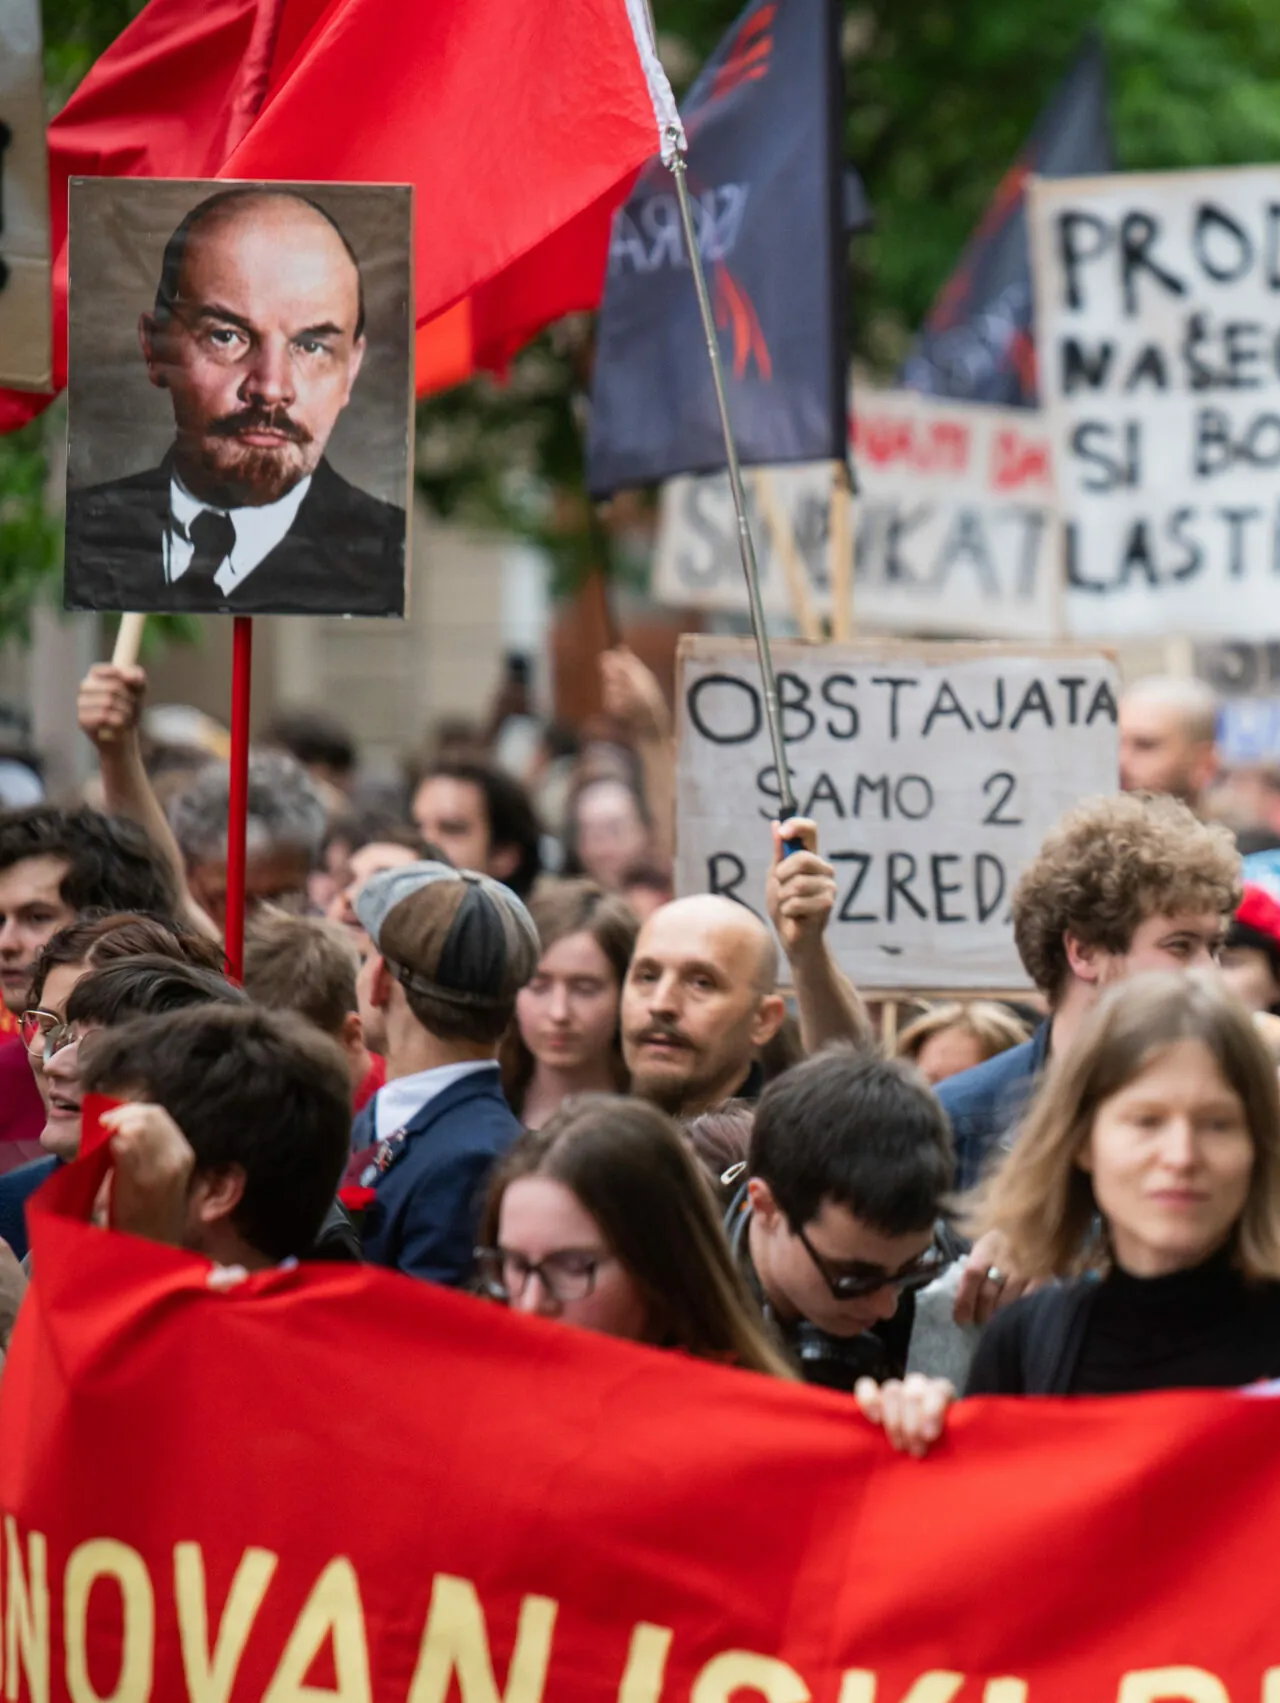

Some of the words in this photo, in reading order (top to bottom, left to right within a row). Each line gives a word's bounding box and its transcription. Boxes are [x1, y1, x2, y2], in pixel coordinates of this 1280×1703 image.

[1070, 416, 1142, 492] SI
[687, 672, 1118, 745] OBSTAJATA
[757, 766, 934, 822] SAMO
[983, 771, 1023, 826] 2
[706, 851, 1018, 924] RZRED
